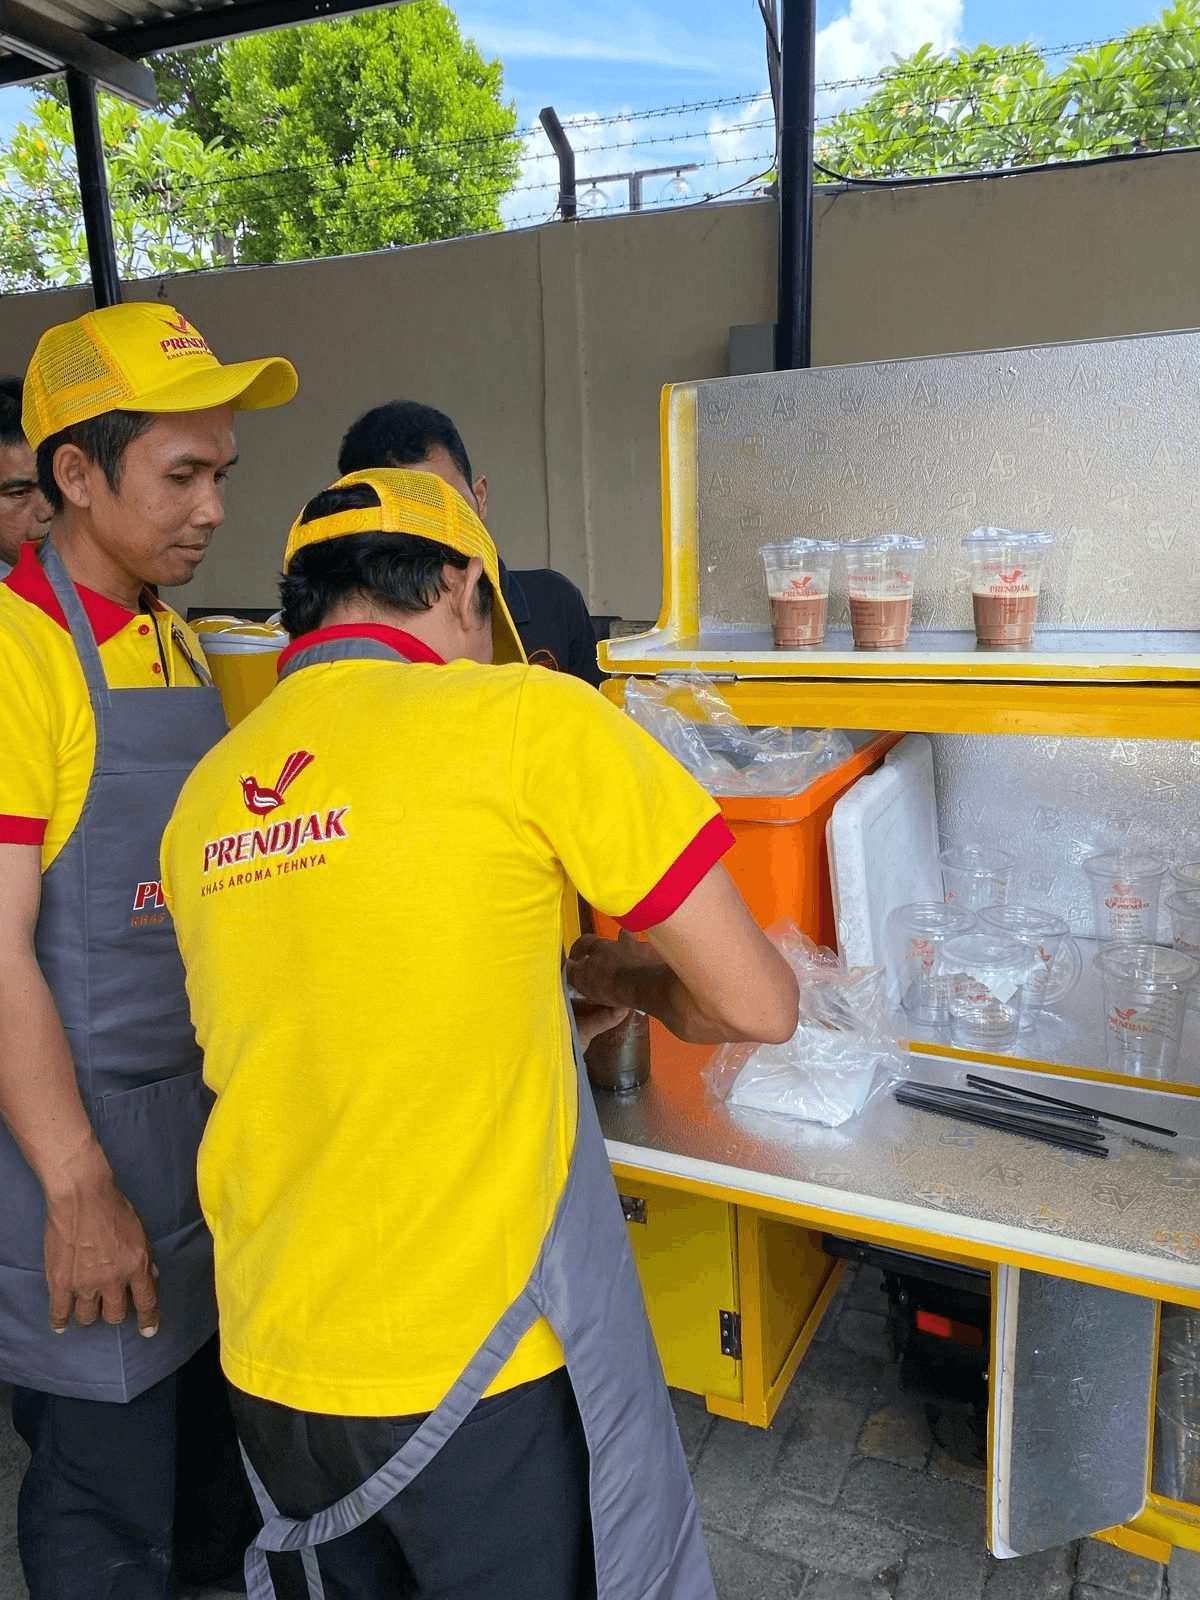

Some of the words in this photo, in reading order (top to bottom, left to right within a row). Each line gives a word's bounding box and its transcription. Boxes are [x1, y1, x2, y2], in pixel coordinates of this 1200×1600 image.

[989, 584, 1031, 593] PRENDJAK
[203, 806, 349, 875] PRENDJAK
[201, 879, 225, 898] KHAS
[227, 867, 272, 888] AROMA
[276, 854, 327, 875] TEHNYA
